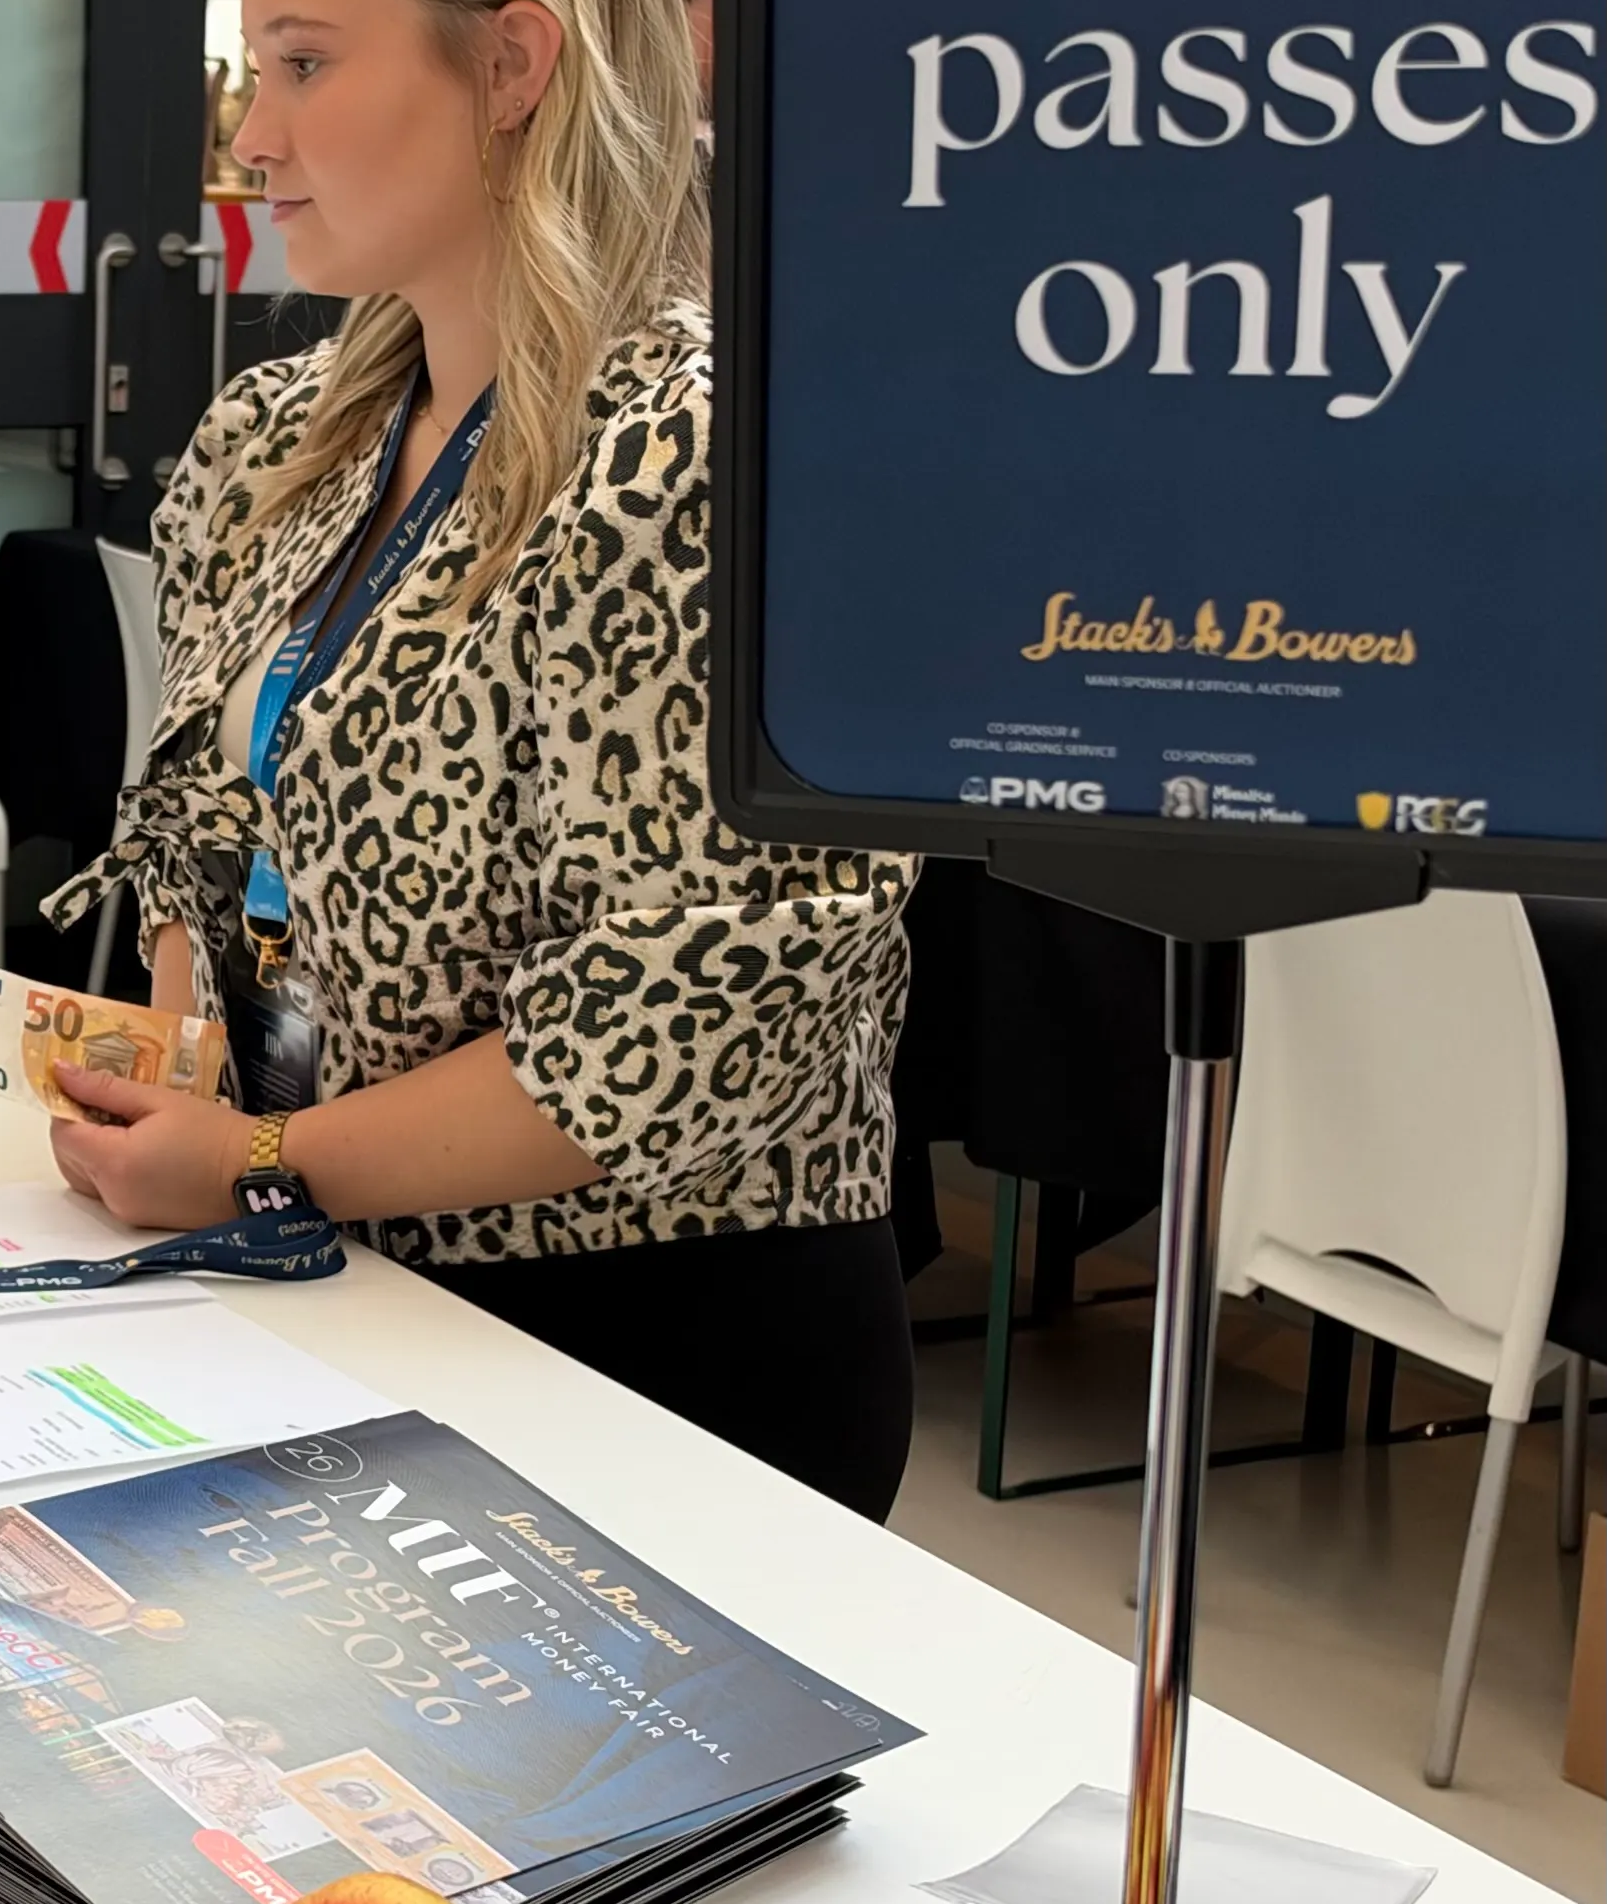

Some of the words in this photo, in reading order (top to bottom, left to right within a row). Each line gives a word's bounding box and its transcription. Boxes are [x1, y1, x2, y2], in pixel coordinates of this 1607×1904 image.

[901, 22, 1598, 208] passes
[1014, 194, 1467, 420] only
[1020, 591, 1177, 662] Stack's
[1223, 599, 1418, 665] Bowers
[1084, 673, 1119, 688] MAIN
[1120, 676, 1182, 692] SPONSOR
[1197, 678, 1253, 695] OFFICIAL
[990, 776, 1107, 813] PMG
[1395, 794, 1489, 837] PCGS
[23, 989, 84, 1043] 50
[15, 1276, 83, 1287] PMG
[284, 1441, 344, 1473] 26
[199, 1517, 332, 1599] Fall
[485, 1509, 578, 1566] Stack's
[585, 1585, 694, 1656] Bowers
[266, 1499, 533, 1707] Program
[302, 1605, 485, 1726] 2026
[521, 1632, 607, 1693] MONEY
[608, 1698, 665, 1740] FAIR
[546, 1624, 734, 1765] INTERNATIONAL
